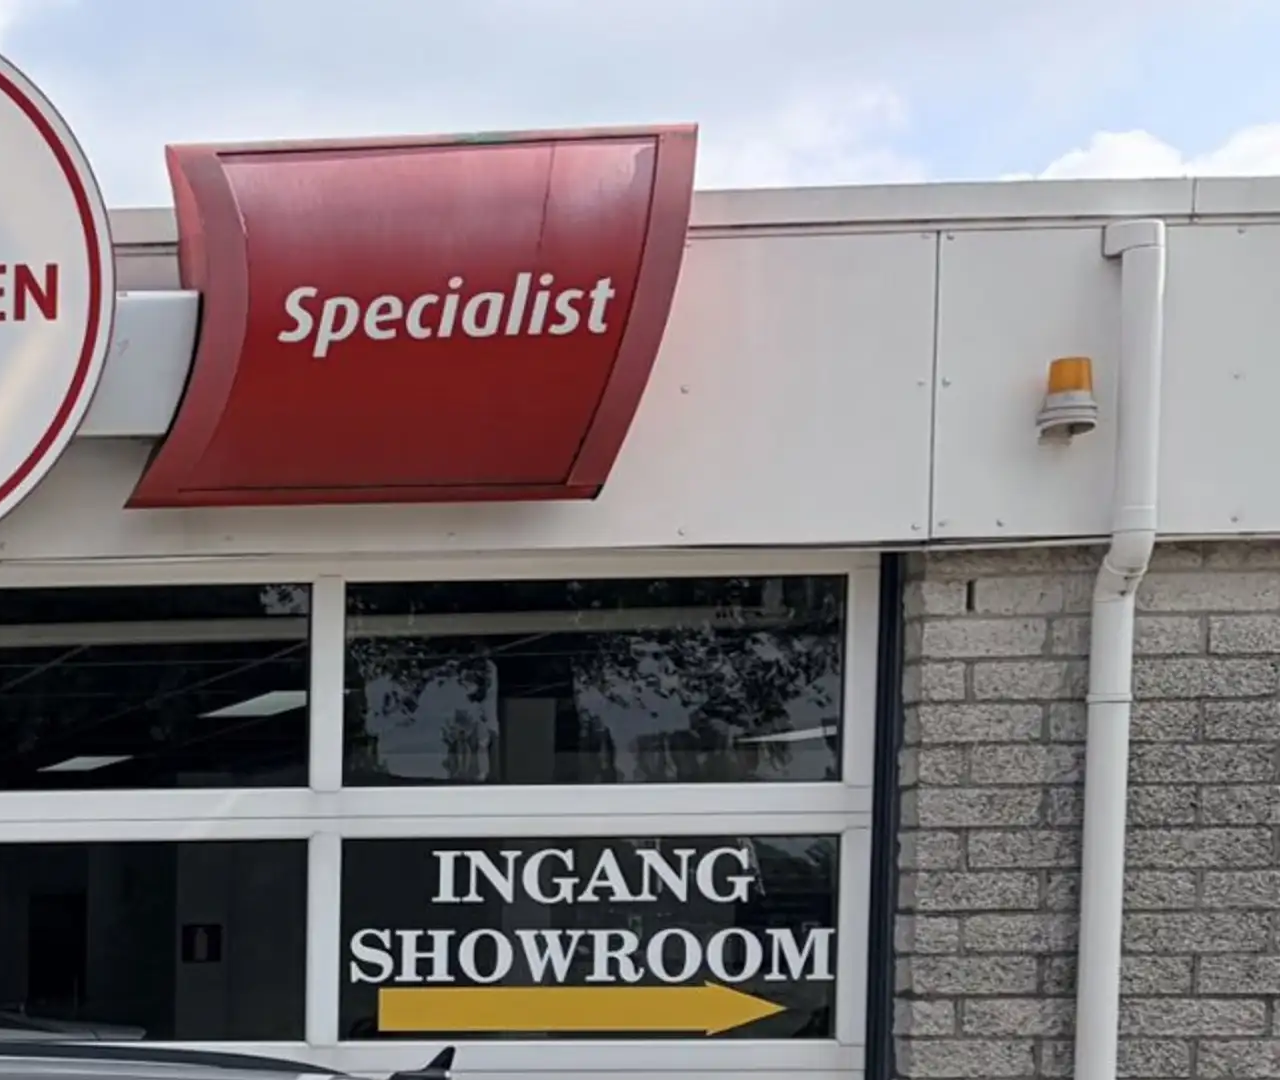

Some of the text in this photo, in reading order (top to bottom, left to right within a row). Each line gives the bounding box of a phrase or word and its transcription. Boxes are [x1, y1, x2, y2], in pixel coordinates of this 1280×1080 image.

[277, 272, 616, 358] Specialist
[431, 847, 756, 905] INGANG
[349, 927, 836, 984] SHOWROOM
